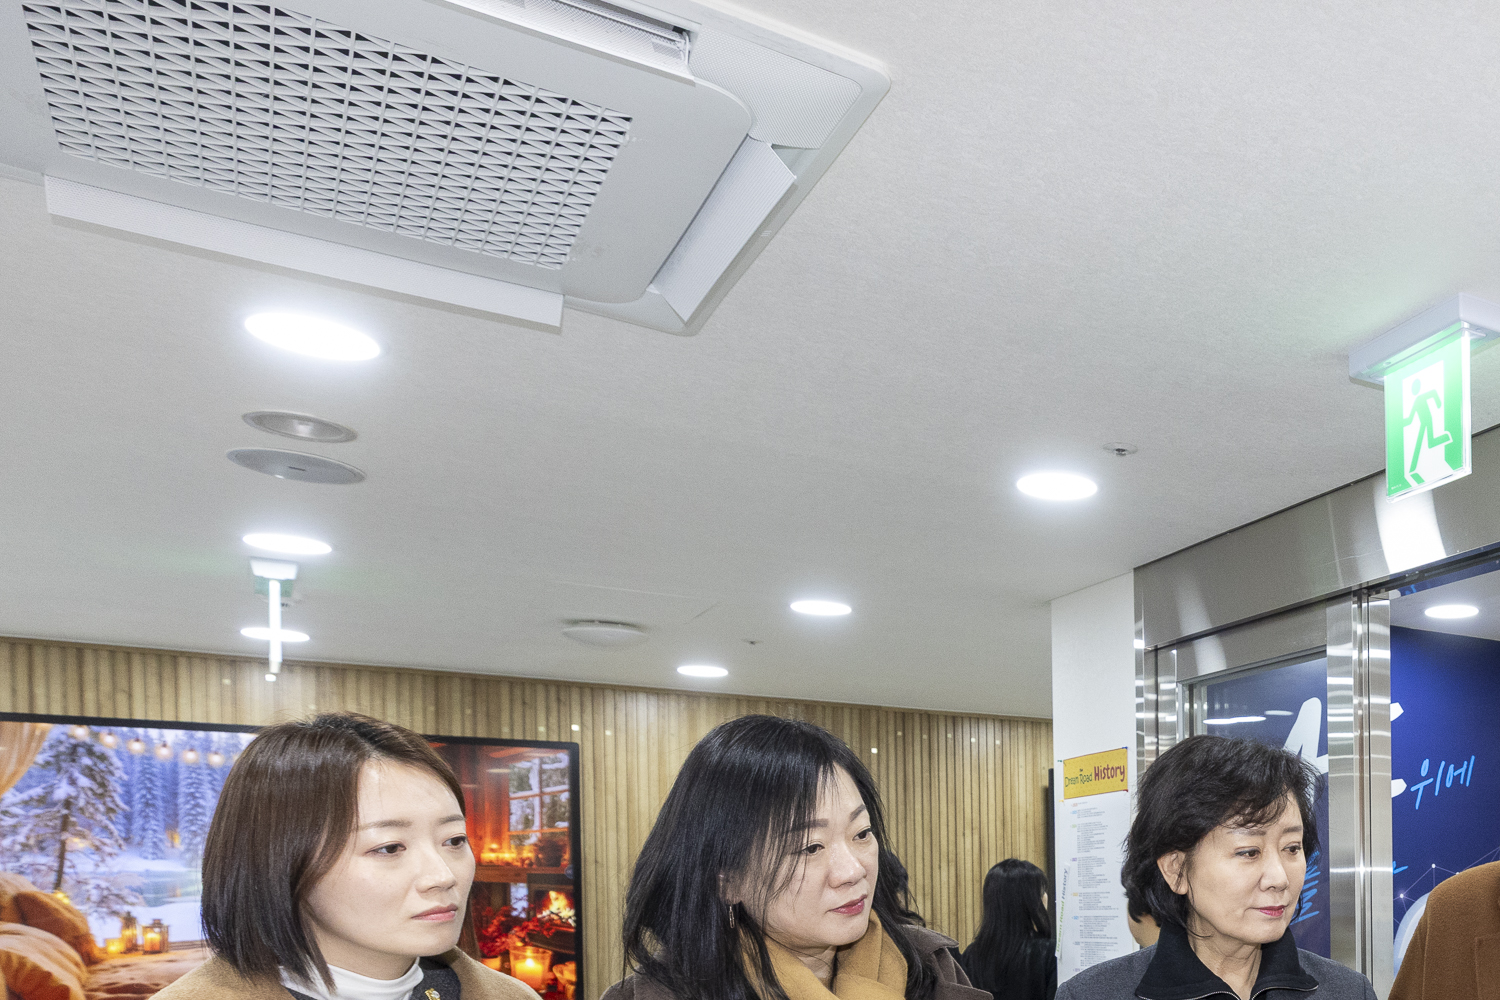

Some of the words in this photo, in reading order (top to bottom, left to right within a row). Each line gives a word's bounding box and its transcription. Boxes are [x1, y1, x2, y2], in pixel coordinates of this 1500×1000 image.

[1065, 777, 1079, 787] Dream
[1079, 772, 1093, 784] Road
[1094, 764, 1125, 782] History
[1410, 755, 1475, 810] 위에
